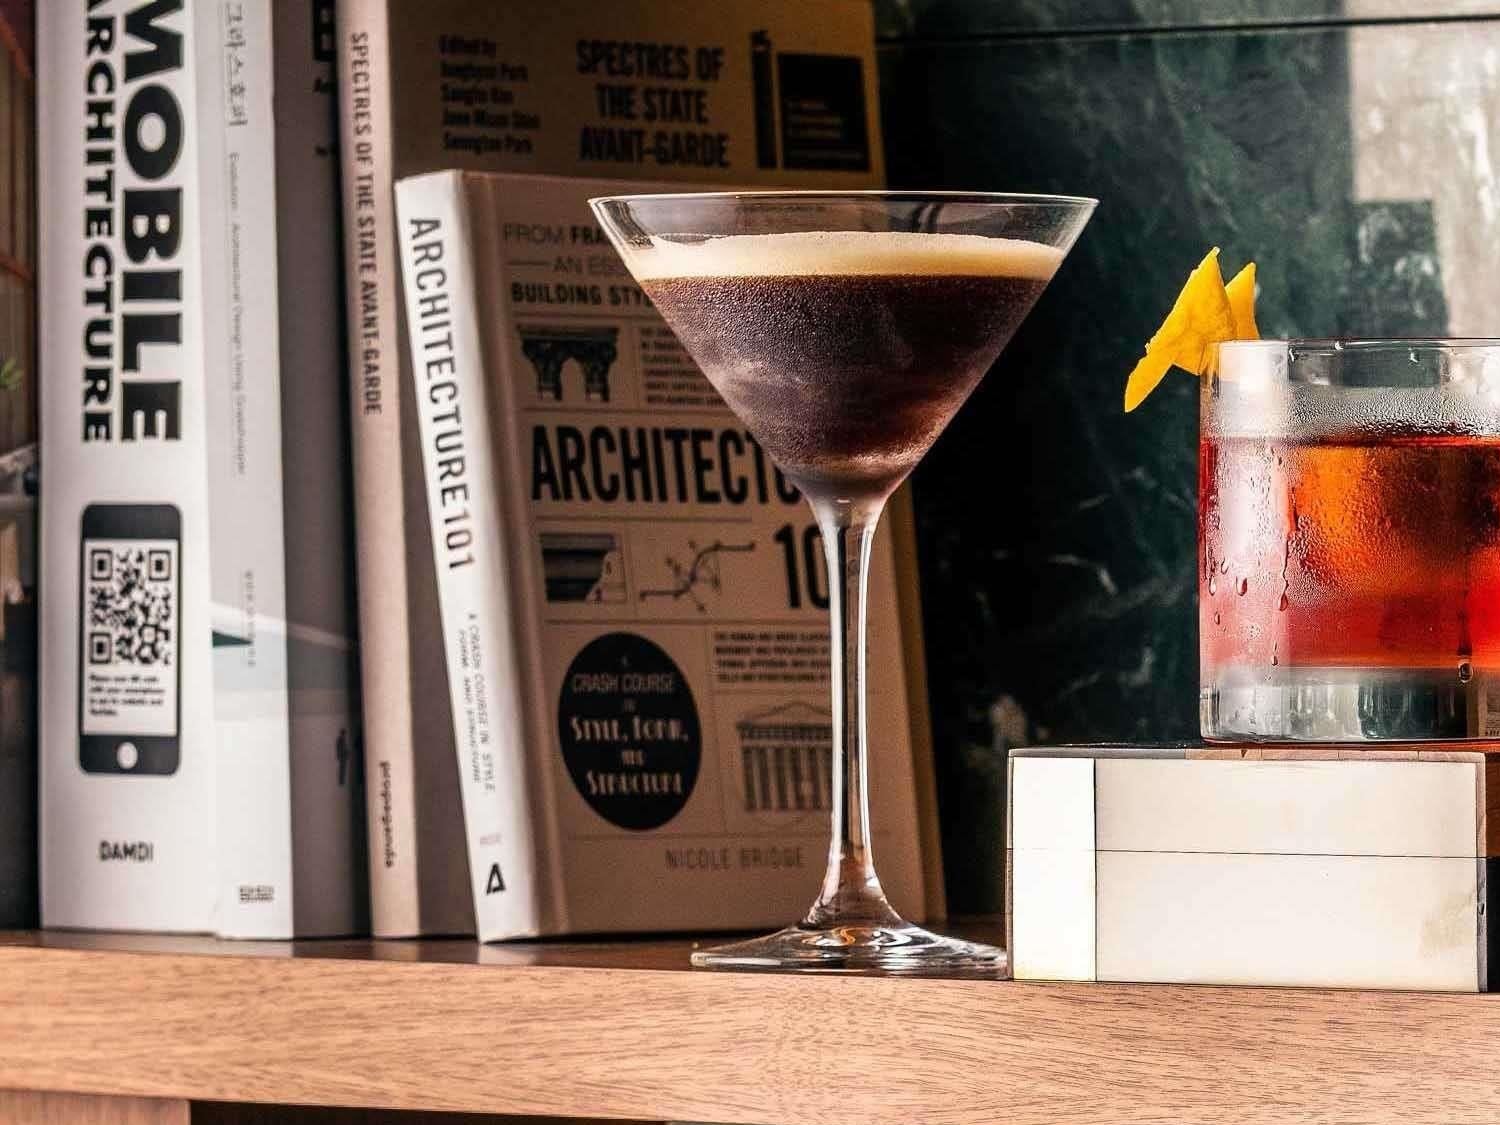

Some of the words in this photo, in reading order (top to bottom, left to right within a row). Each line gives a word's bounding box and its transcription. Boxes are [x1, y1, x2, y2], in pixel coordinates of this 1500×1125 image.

[576, 40, 690, 80] SPECTRES
[695, 47, 725, 82] OF
[351, 32, 370, 136] SPECTRES
[596, 83, 637, 120] THE
[643, 86, 709, 125] STATE
[355, 140, 373, 167] OF
[580, 127, 731, 168] AVANT-GARDE
[356, 171, 375, 207] THE
[122, 0, 184, 442] MOBILE
[358, 214, 378, 276] STATE
[511, 282, 601, 305] BUILDING
[361, 281, 382, 415] AVANT-GARDE
[408, 217, 468, 507] ARCHITECTURE
[444, 508, 475, 570] 101
[99, 840, 154, 862] DAMDI
